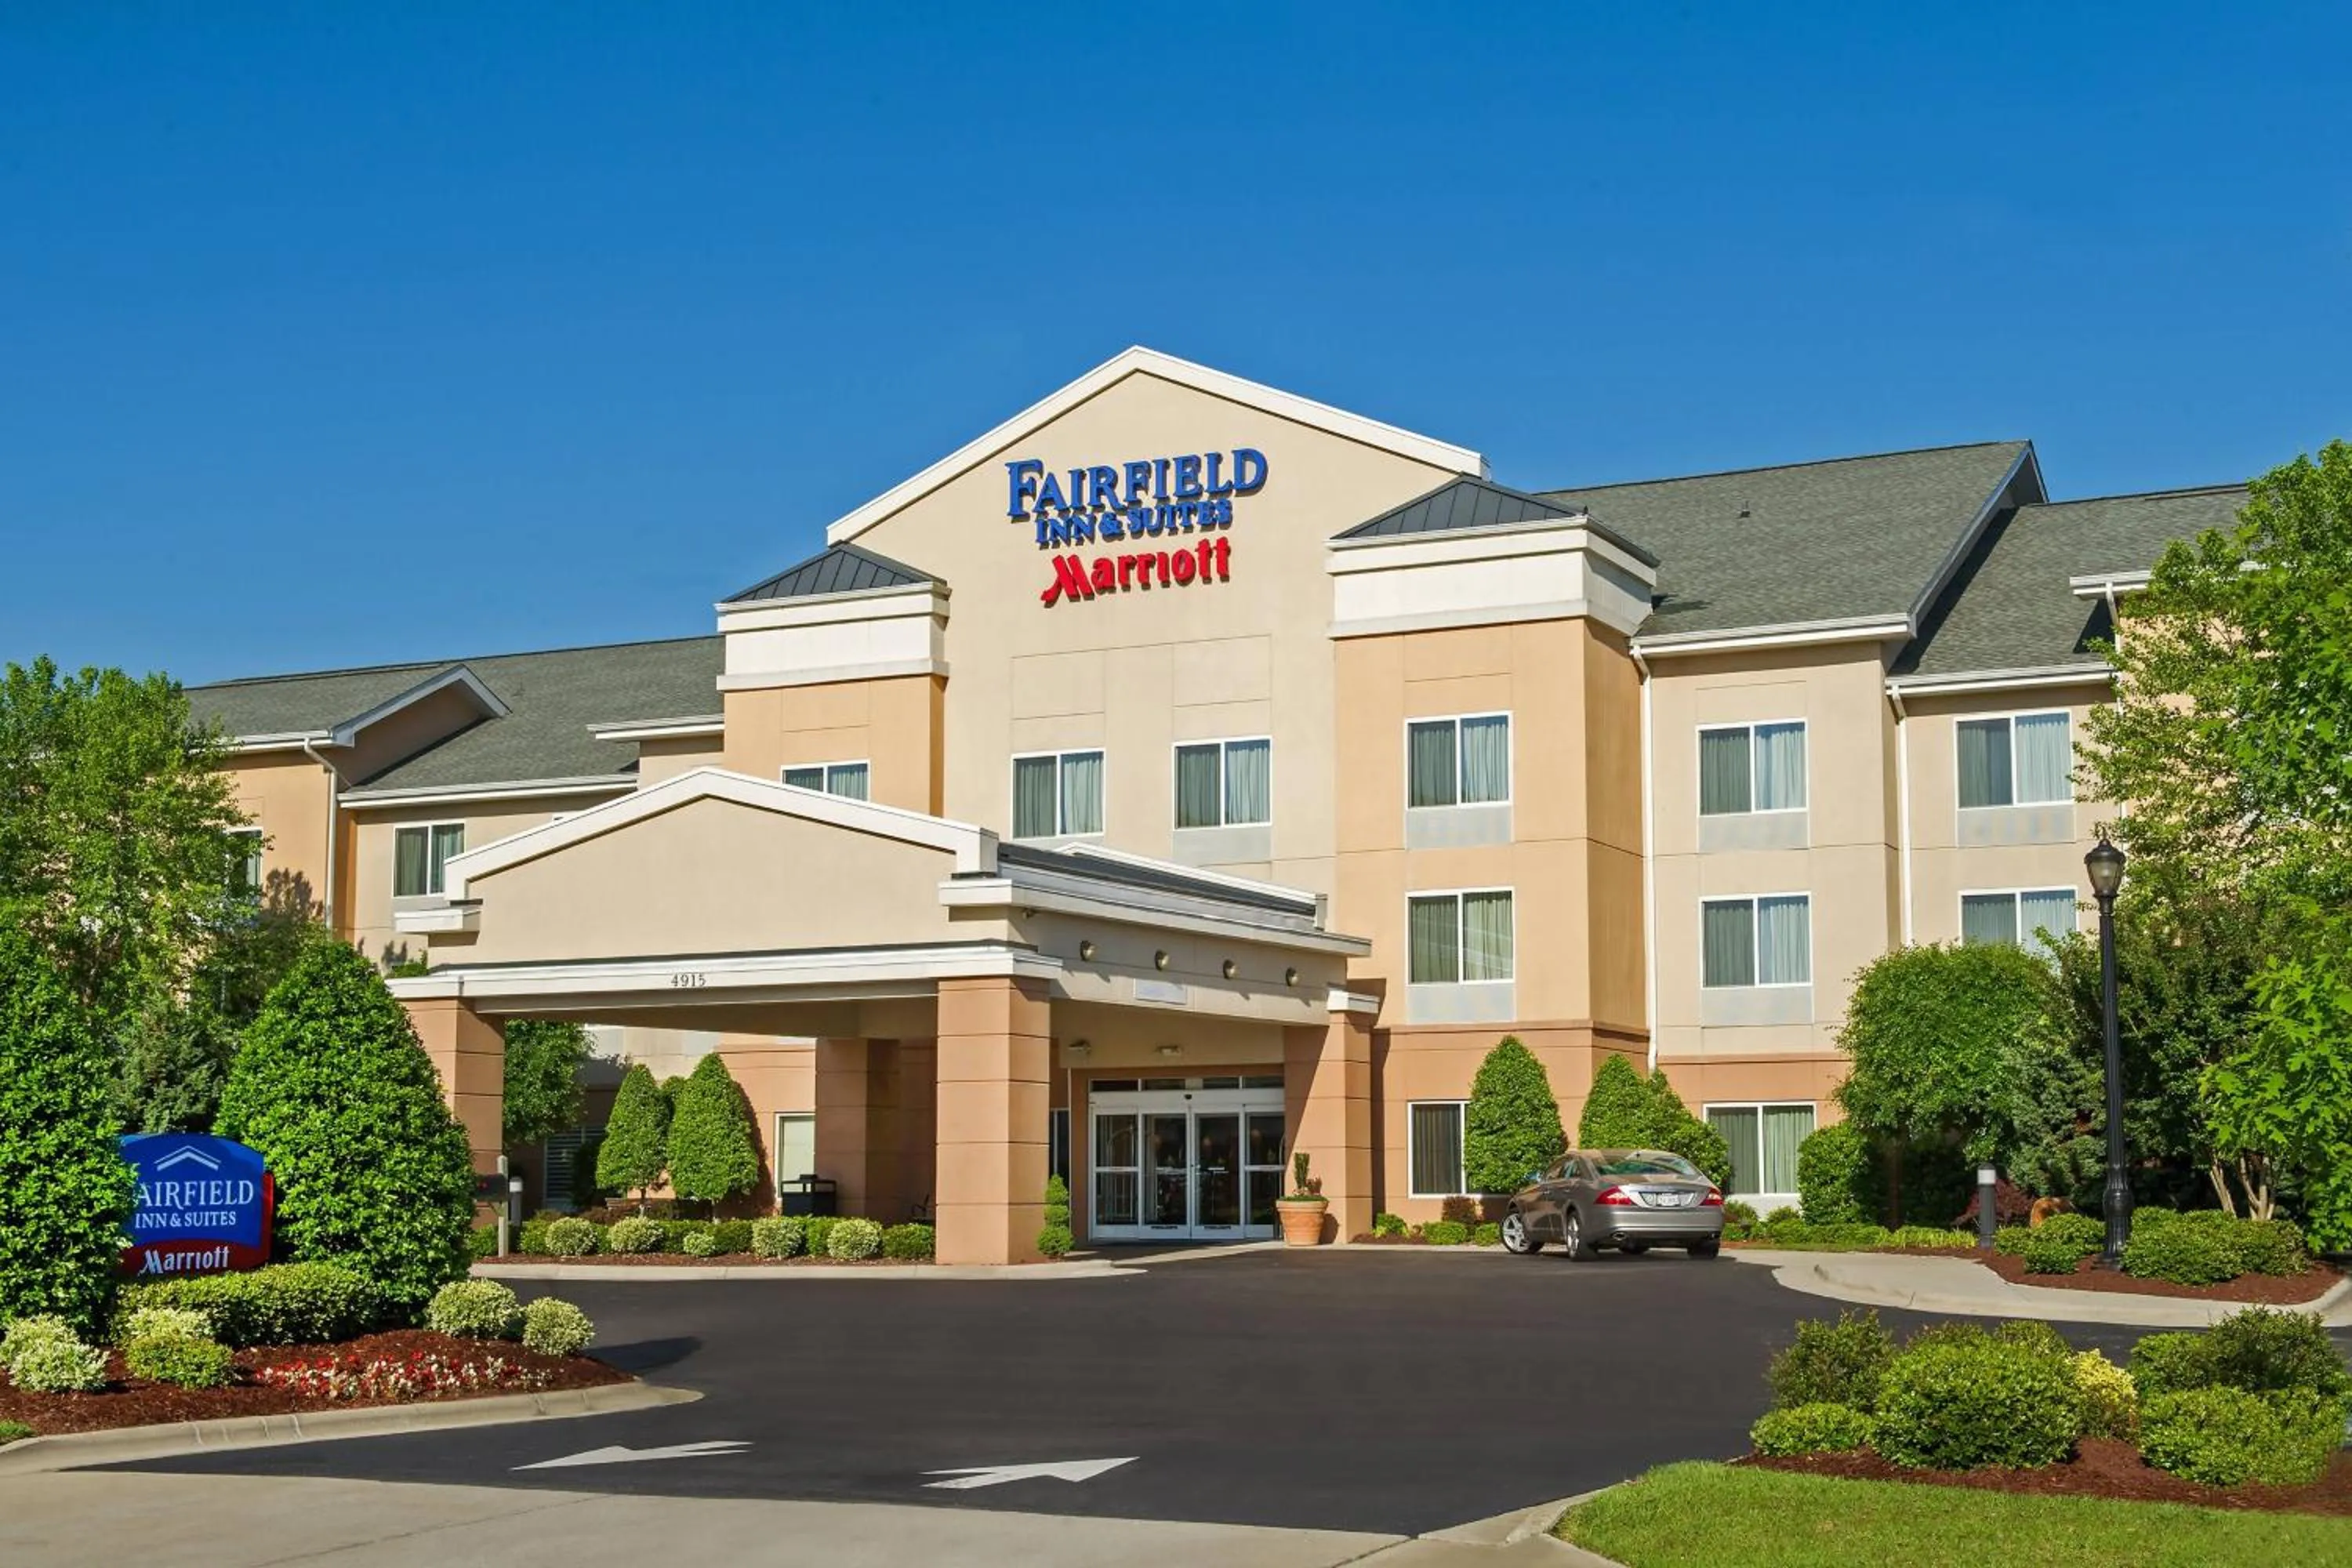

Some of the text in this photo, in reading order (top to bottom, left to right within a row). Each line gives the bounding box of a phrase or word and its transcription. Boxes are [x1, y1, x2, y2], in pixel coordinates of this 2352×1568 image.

[1005, 448, 1269, 521] FAIRFIELD
[1034, 513, 1095, 549] INN
[1127, 499, 1233, 539] SUITES
[1040, 536, 1232, 608] Marriott
[670, 973, 706, 987] 4915
[137, 1180, 254, 1210] AIRFIELD
[135, 1212, 168, 1229] INN
[184, 1210, 236, 1227] SUITES
[137, 1245, 230, 1276] Marriott
